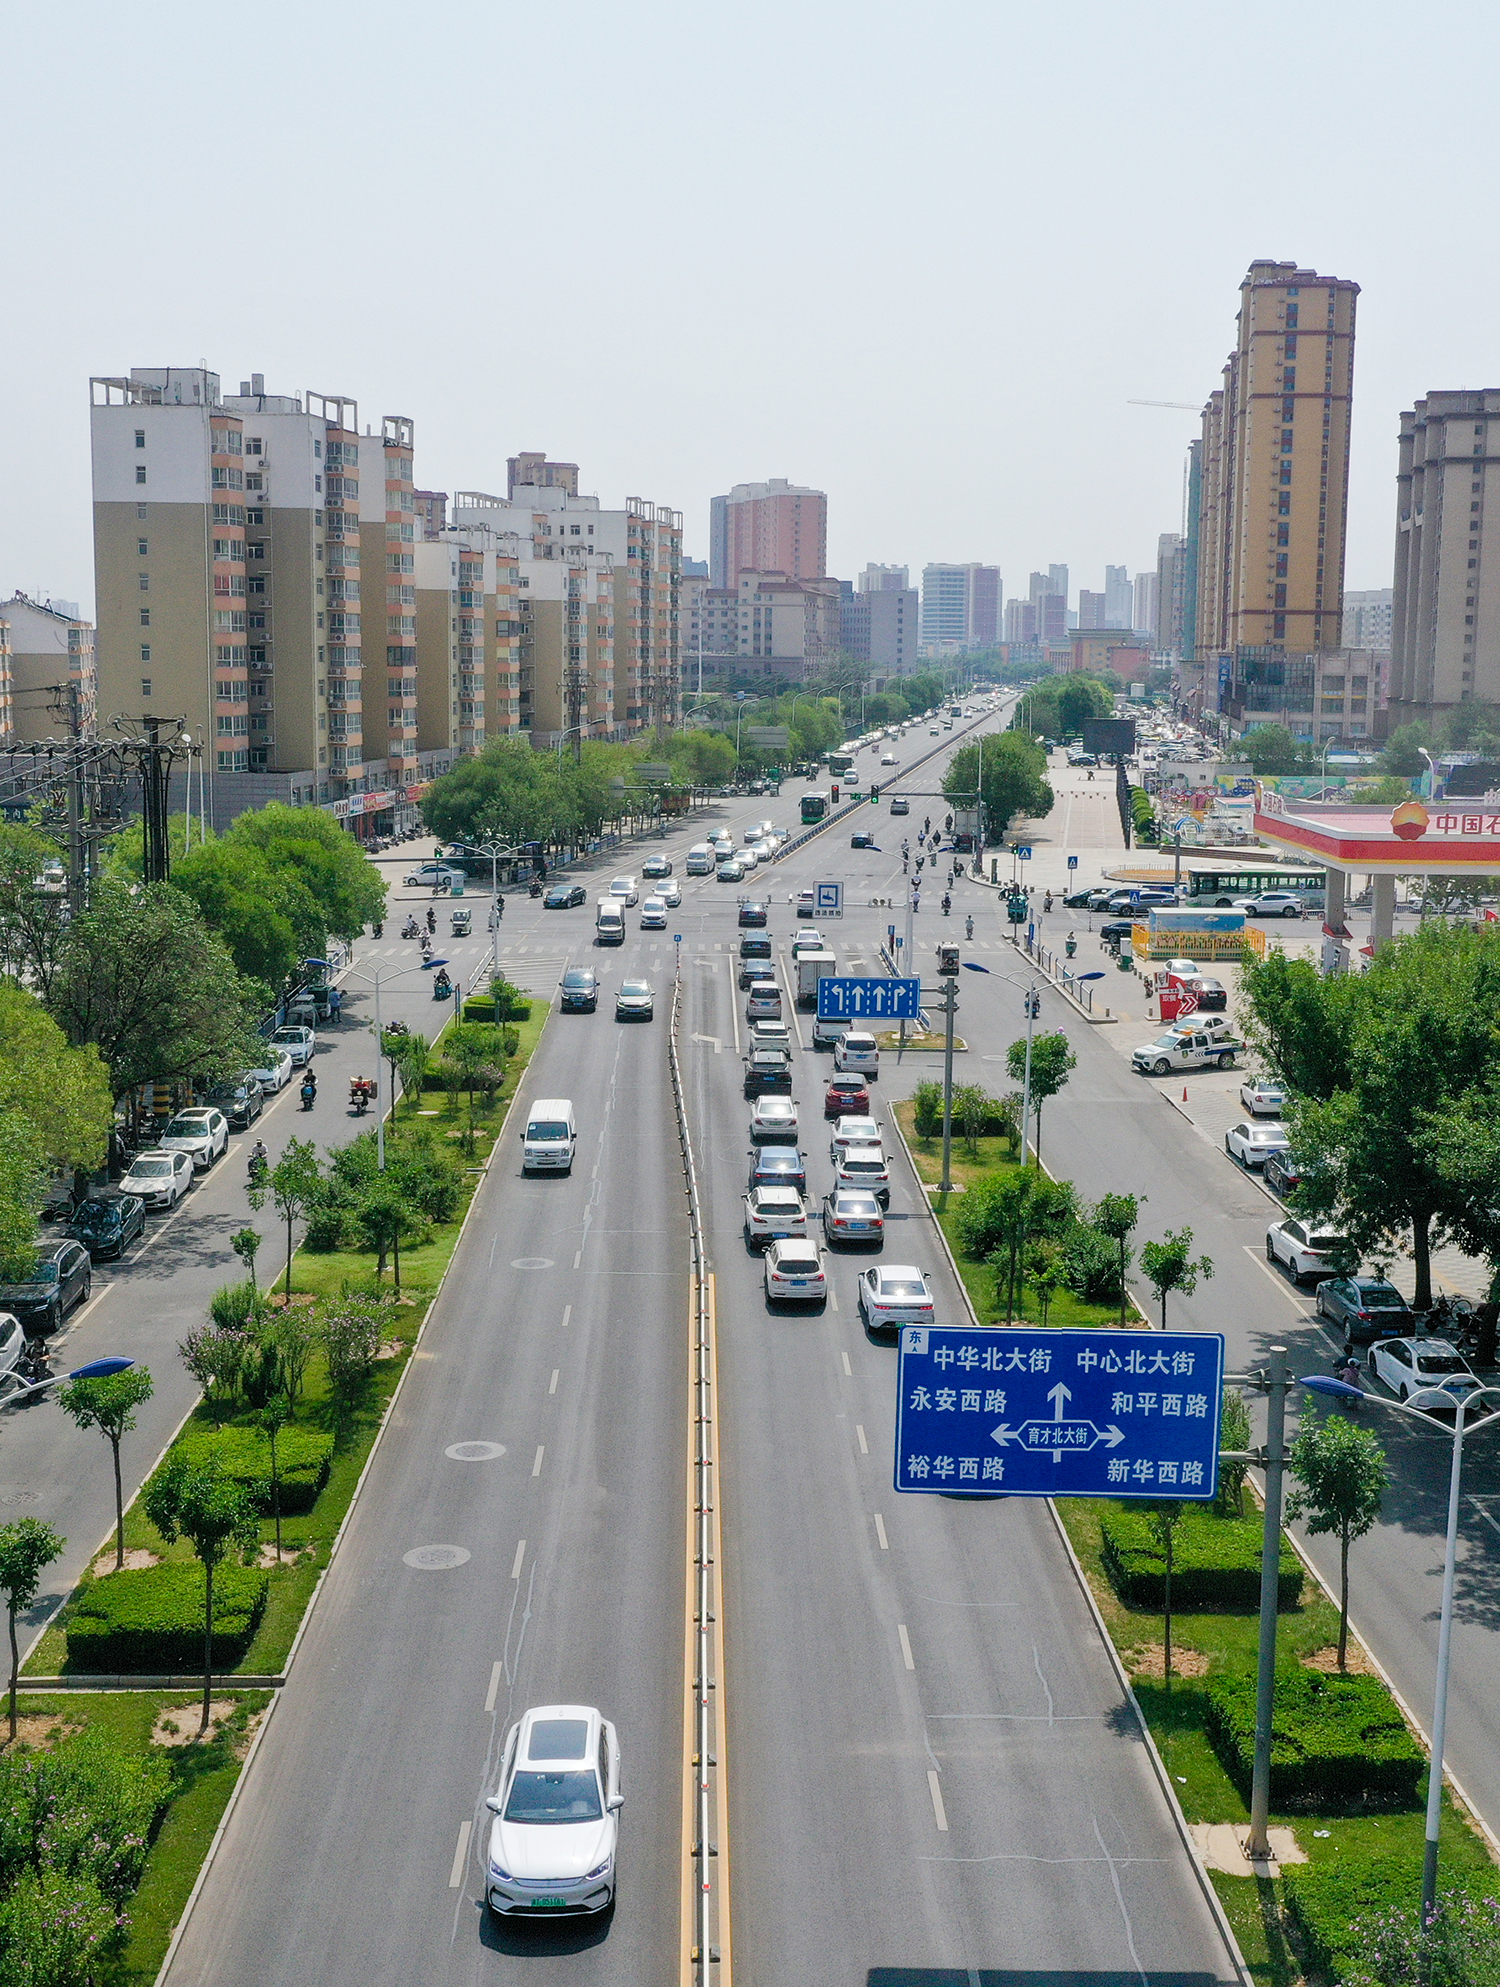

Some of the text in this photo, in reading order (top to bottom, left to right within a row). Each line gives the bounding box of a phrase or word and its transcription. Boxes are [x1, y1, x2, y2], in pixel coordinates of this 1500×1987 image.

[909, 1330, 921, 1344] 东
[933, 1345, 1195, 1376] 中华北大街 中心北大街
[910, 1386, 1007, 1414] 永安西路
[1111, 1391, 1208, 1418] 和平西路
[1028, 1427, 1087, 1444] 育才北大街
[908, 1454, 1005, 1480] 裕华西路
[1107, 1458, 1204, 1485] 新华西路
